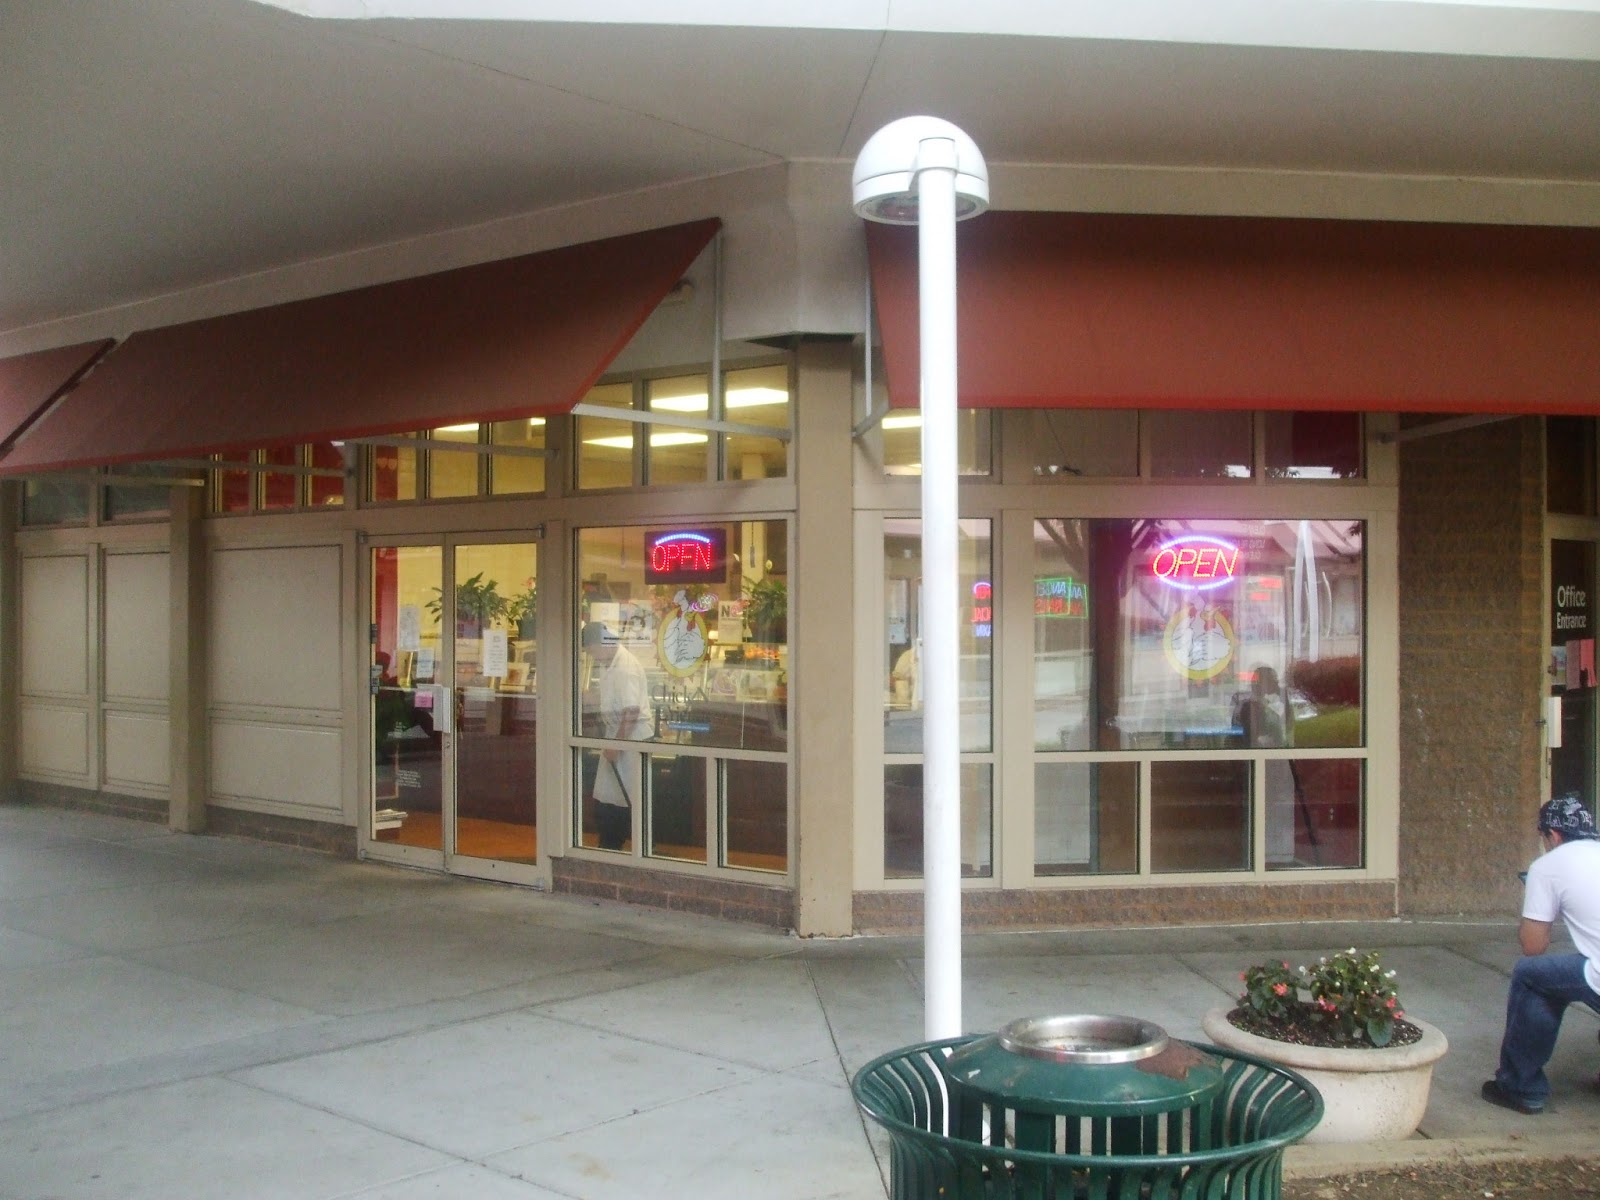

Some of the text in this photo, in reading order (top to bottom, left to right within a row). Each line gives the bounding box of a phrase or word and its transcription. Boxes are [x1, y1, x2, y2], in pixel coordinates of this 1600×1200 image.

[653, 543, 711, 571] OPEN
[1153, 547, 1239, 577] OPEN
[1557, 585, 1586, 608] Office
[1556, 612, 1587, 629] Entrance
